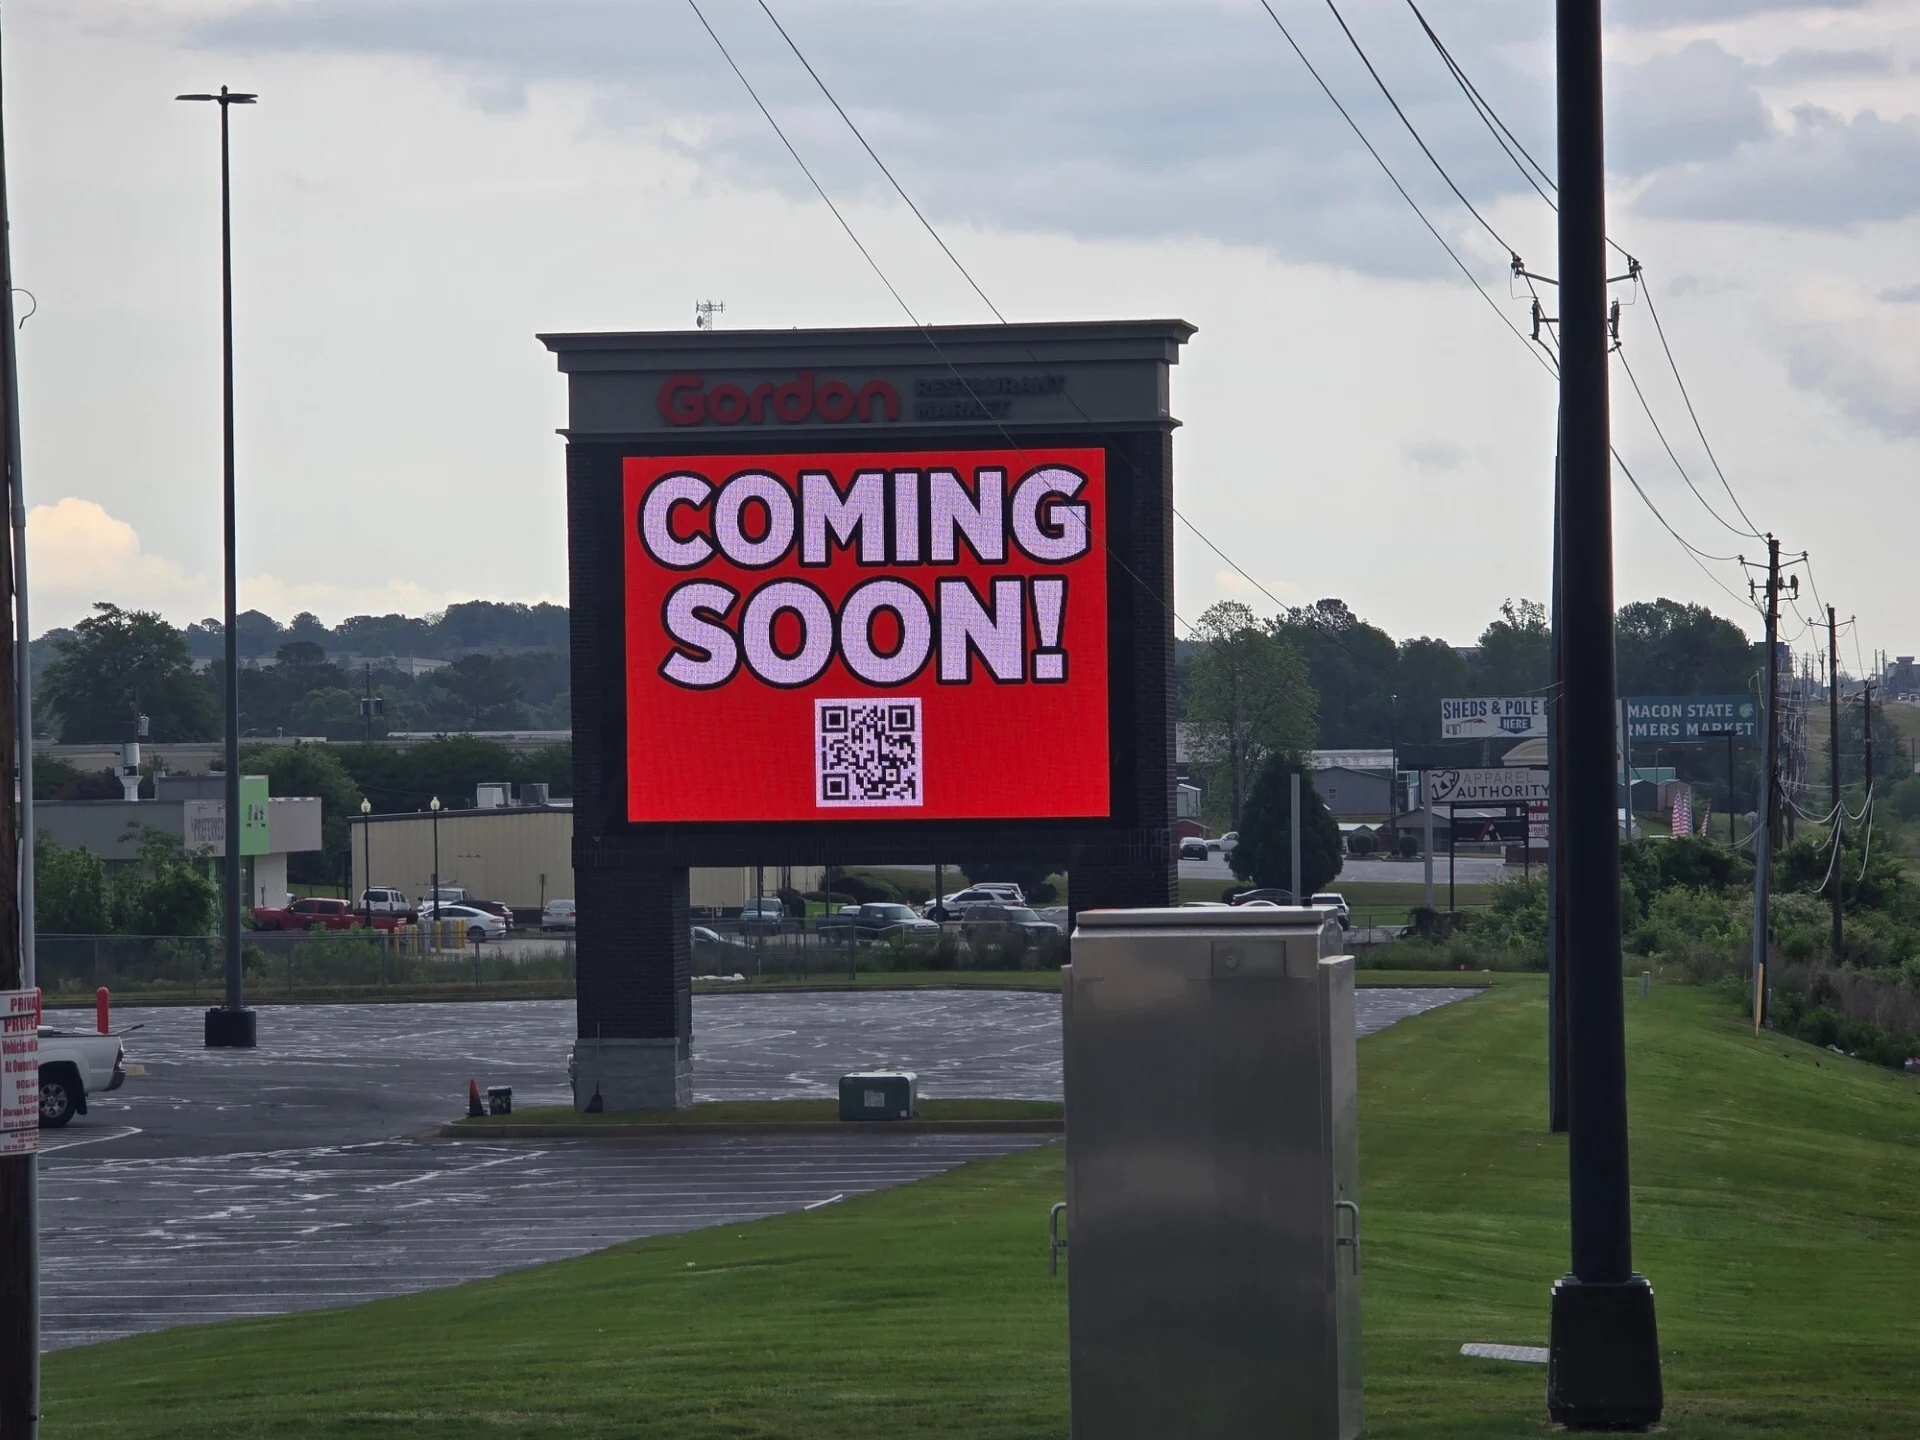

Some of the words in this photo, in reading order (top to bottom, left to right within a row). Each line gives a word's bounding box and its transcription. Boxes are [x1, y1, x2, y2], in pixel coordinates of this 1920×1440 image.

[913, 374, 1066, 397] RESTAURANT
[658, 371, 900, 426] Gordon
[913, 398, 1012, 421] MARKET
[640, 466, 1090, 568] COMING
[660, 577, 1067, 687] SOON!
[1443, 700, 1487, 719] SHEDS
[1491, 701, 1501, 715] &
[1505, 700, 1539, 716] POLE
[1628, 704, 1682, 718] MACON
[1687, 703, 1734, 718] STATE
[1503, 718, 1529, 729] HERE
[1463, 770, 1534, 784] APPAREL
[1456, 784, 1550, 799] AUTHORITY
